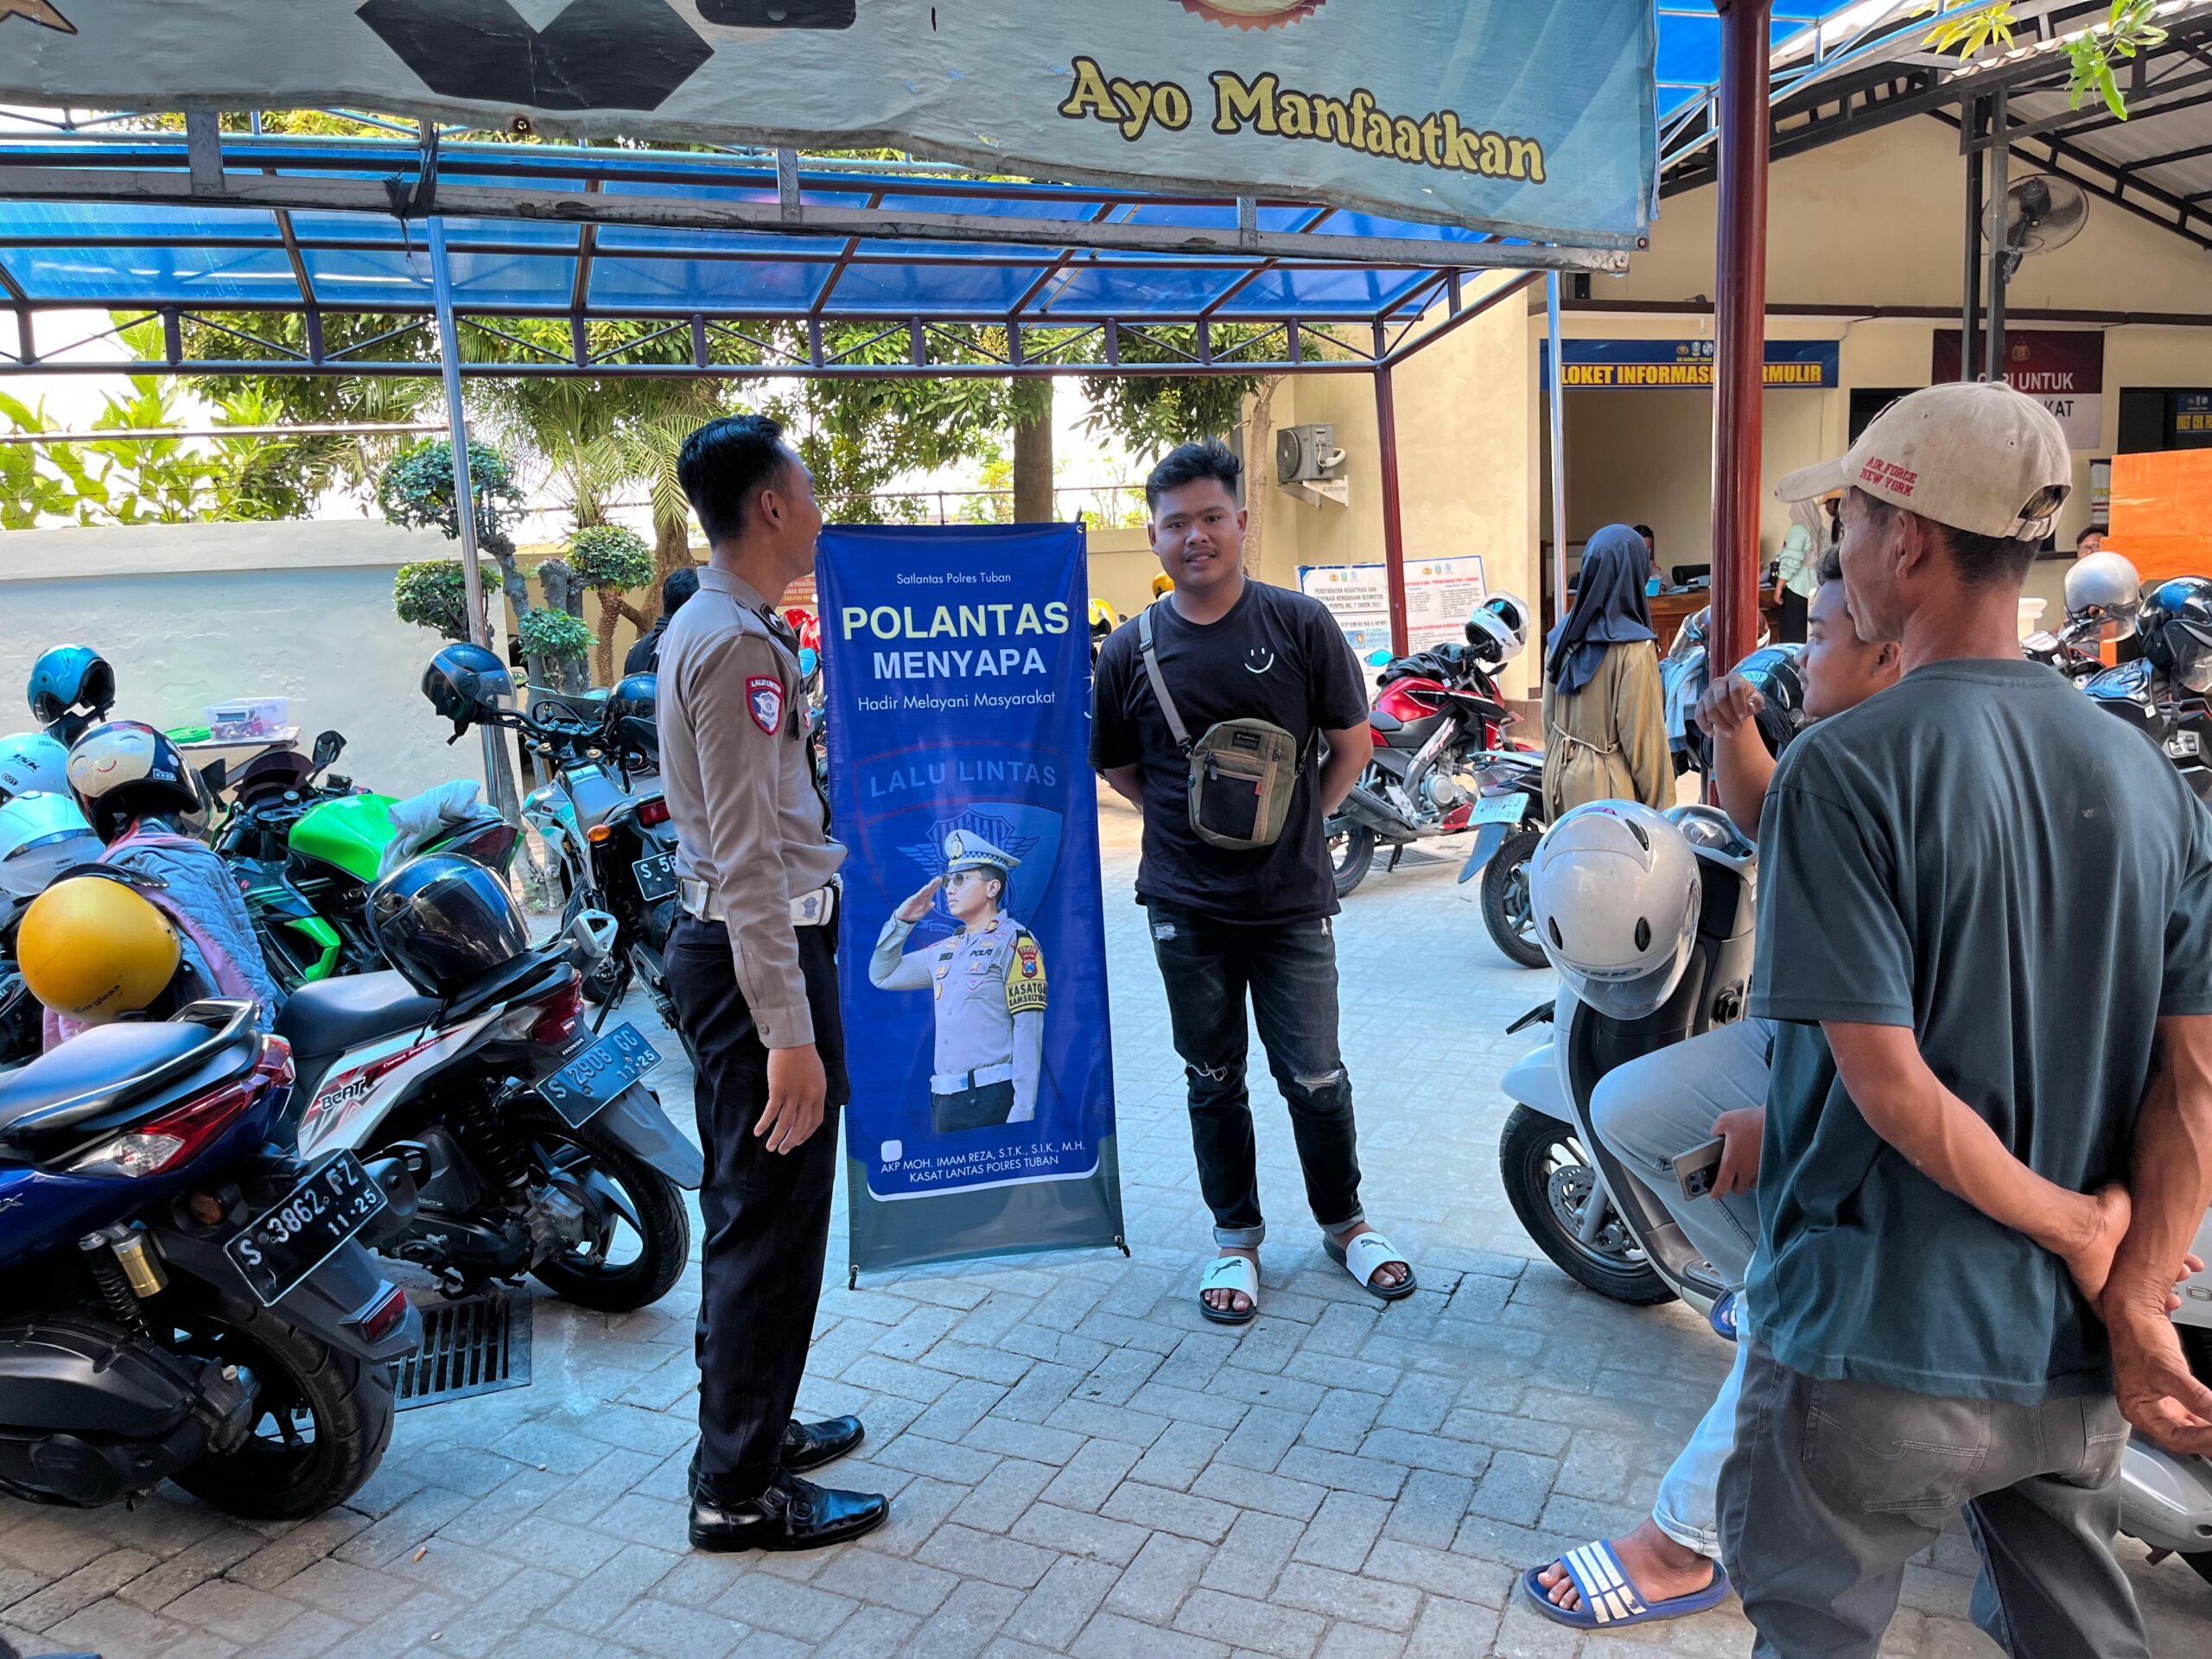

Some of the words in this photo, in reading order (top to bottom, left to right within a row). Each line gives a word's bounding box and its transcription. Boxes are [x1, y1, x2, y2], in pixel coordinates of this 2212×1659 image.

[1058, 55, 1192, 141] Ayo
[1210, 70, 1547, 184] Manfaatkan
[1561, 365, 1613, 385] LOKET
[1763, 364, 1822, 383] RMULIR
[2018, 372, 2074, 390] UNTUK
[1866, 456, 1884, 471] AIR
[1884, 463, 1917, 484] FORCE
[1859, 467, 1884, 484] NEW
[1885, 477, 1914, 497] YORK
[896, 573, 944, 584] Satlantas
[947, 572, 976, 583] Polres
[980, 571, 1011, 582] Tuban
[842, 601, 1069, 640] POLANTAS
[874, 648, 1046, 679] MENYAPA
[751, 678, 766, 687] LALU
[1745, 672, 1764, 681] DOT
[858, 694, 898, 711] Hadir
[904, 694, 969, 712] Melayani
[974, 689, 1056, 709] Masyarakat
[12, 753, 41, 771] INK
[3, 774, 17, 785] DOT
[870, 762, 945, 798] LALU
[959, 760, 1057, 787] LINTAS
[640, 863, 652, 879] S
[969, 948, 994, 957] POLRI
[562, 1038, 584, 1055] HONDA
[548, 1080, 568, 1099] S
[567, 1046, 613, 1087] 2908
[881, 1162, 900, 1173] AKP
[903, 1159, 933, 1170] MOH.
[937, 1154, 965, 1166] IMAM
[969, 1151, 995, 1161] REZA,
[1062, 1141, 1085, 1152] M.H.
[910, 1170, 942, 1183] KASAT
[946, 1166, 983, 1179] LANTAS
[987, 1162, 1021, 1173] POLRES
[1024, 1155, 1058, 1167] TUBAN
[239, 1238, 263, 1265] S
[267, 1188, 326, 1243] 3862
